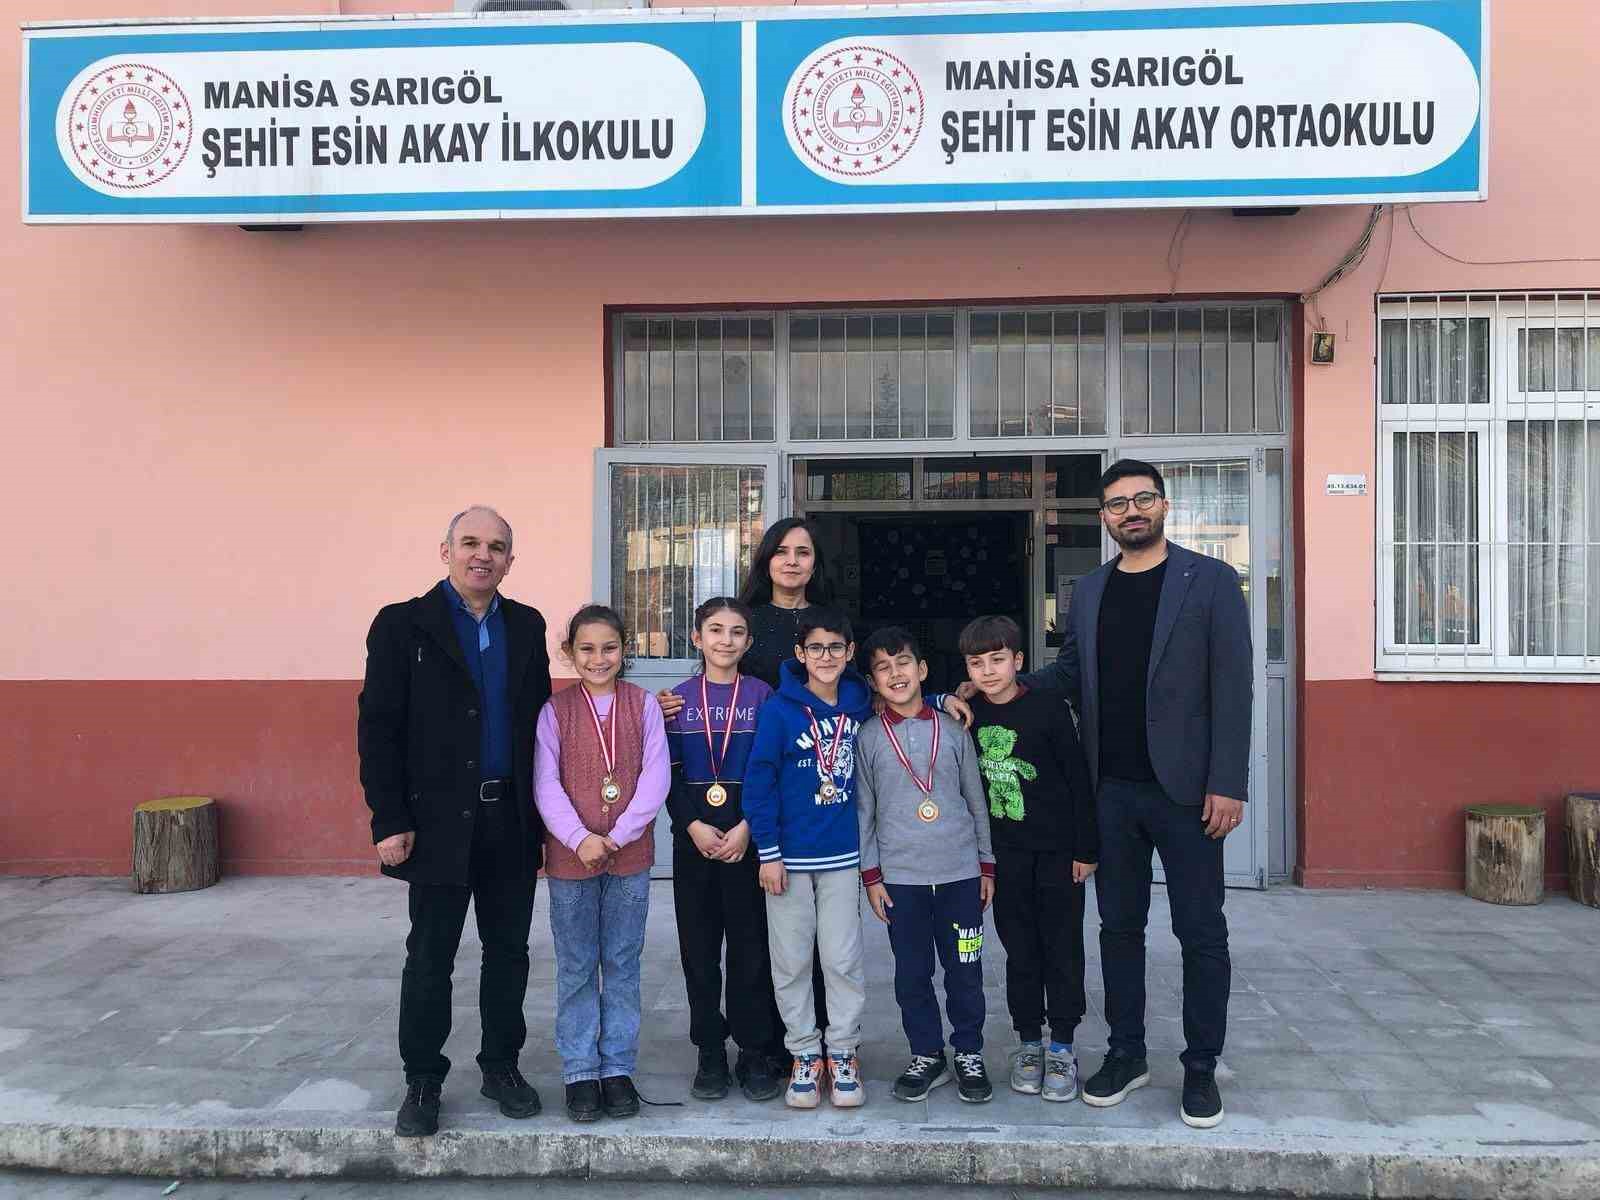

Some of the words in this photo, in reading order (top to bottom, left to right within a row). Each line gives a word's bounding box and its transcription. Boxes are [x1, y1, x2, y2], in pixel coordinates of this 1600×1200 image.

[205, 73, 339, 109] MANİSA
[350, 71, 503, 107] SARIGÖL
[946, 52, 1080, 91] MANİSA
[1091, 48, 1244, 89] SARIGÖL
[202, 117, 300, 179] ŞEHİT
[312, 115, 387, 166] ESİN
[399, 123, 490, 164] AKAY
[502, 112, 674, 162] İLKOKULU
[941, 99, 1036, 165] ŞEHİT
[1047, 97, 1120, 152] ESİN
[1131, 107, 1220, 150] AKAY
[1231, 101, 1435, 149] ORTAOKULU
